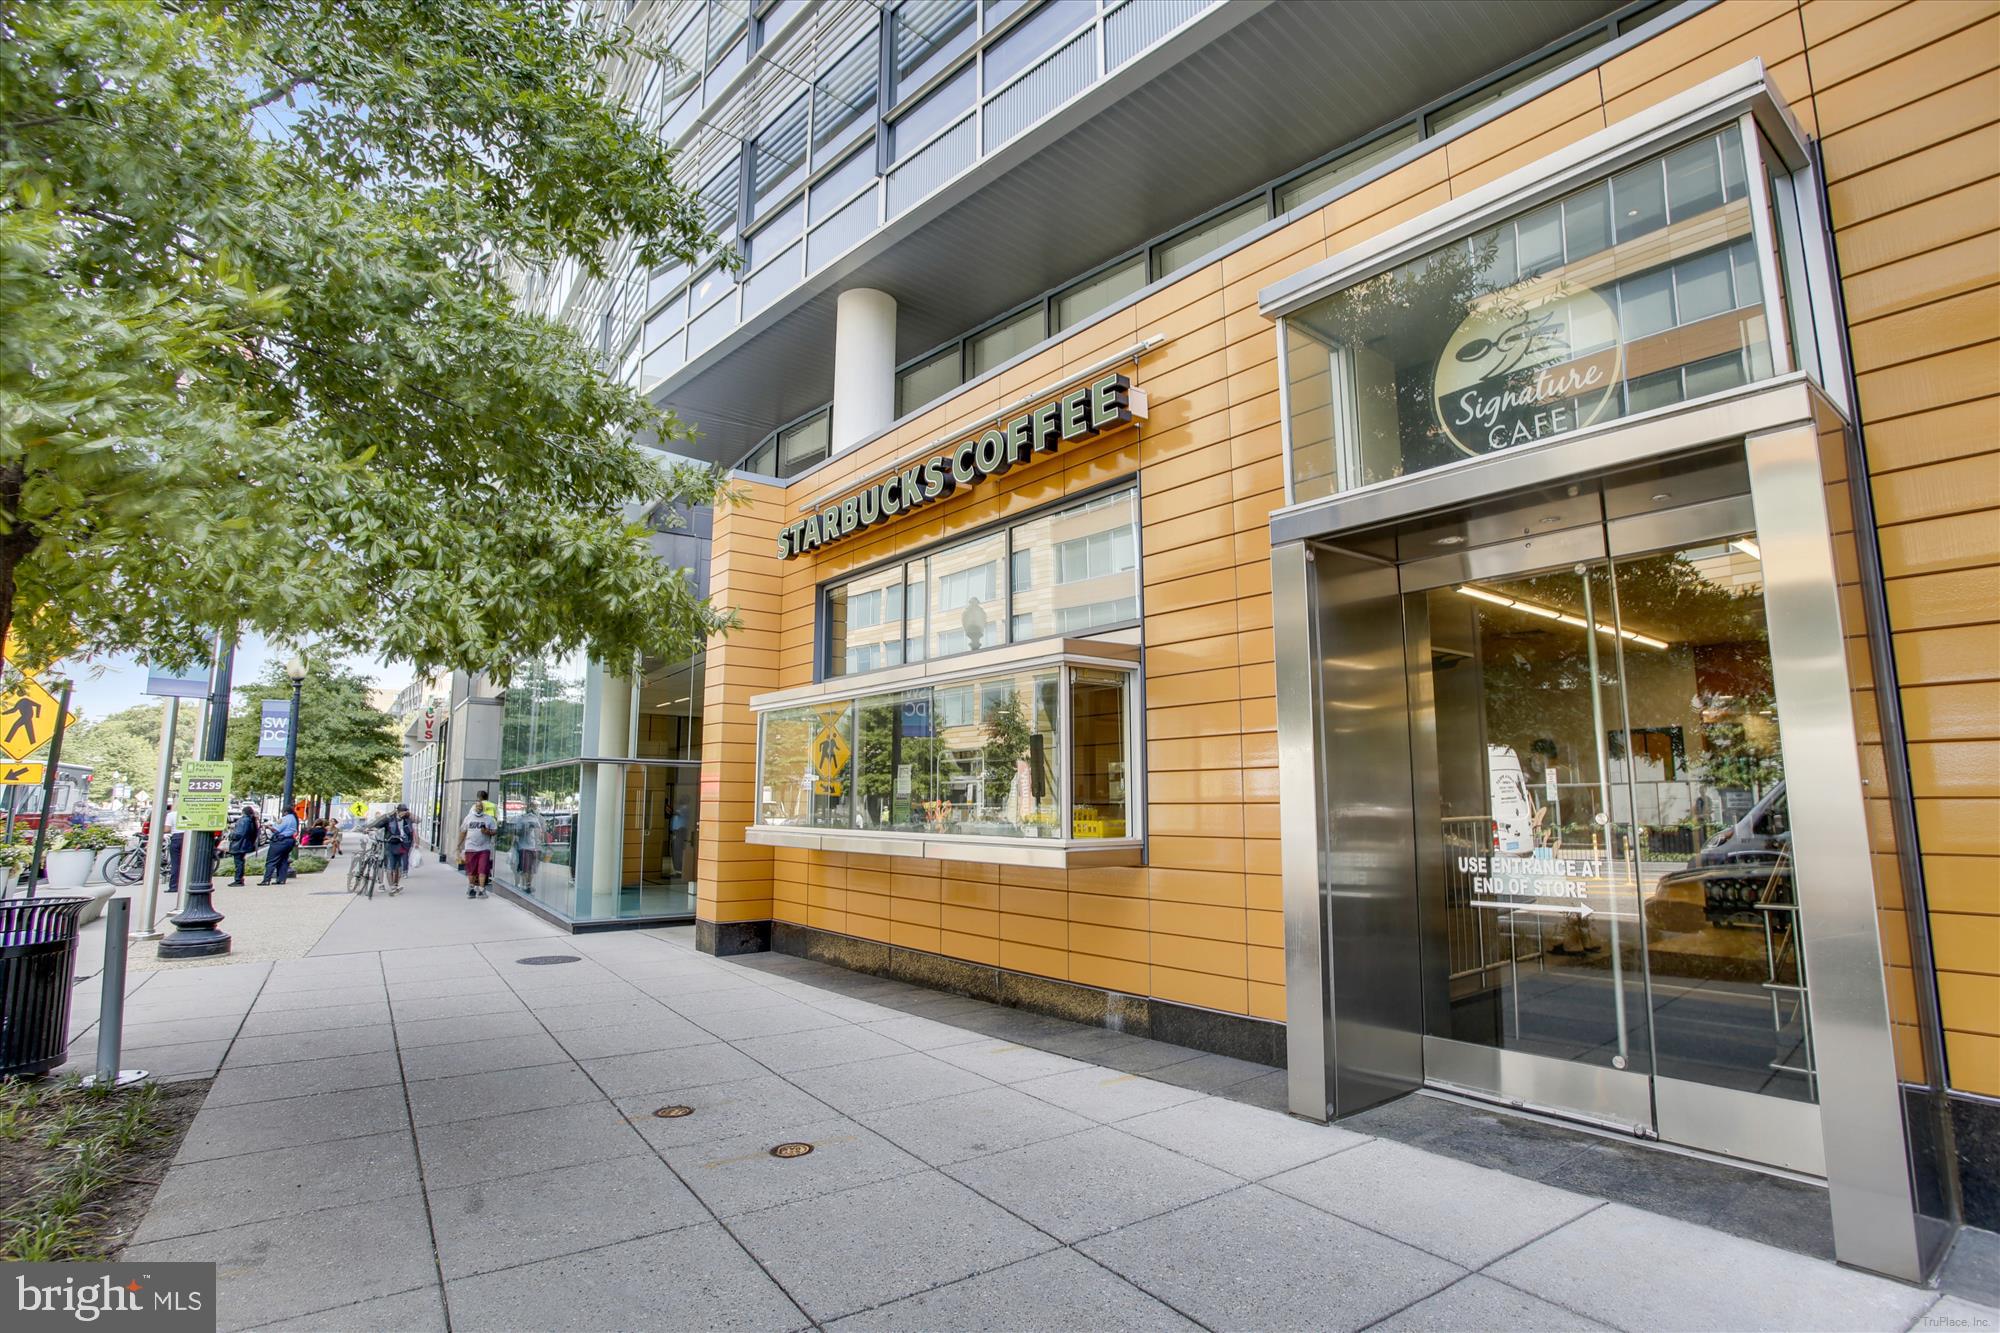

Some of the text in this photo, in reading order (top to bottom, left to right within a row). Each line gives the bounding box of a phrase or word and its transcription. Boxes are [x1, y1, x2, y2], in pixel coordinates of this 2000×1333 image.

[1455, 364, 1604, 428] Signature
[1488, 407, 1568, 449] CAFE
[776, 372, 1129, 560] STARBUCKS COFFEE
[263, 717, 288, 728] SW
[424, 709, 434, 740] CVS
[263, 730, 286, 741] DC
[189, 781, 222, 790] 21299
[1458, 856, 1602, 878] USE ENTRANCE AT
[1474, 877, 1588, 898] END OF STORE
